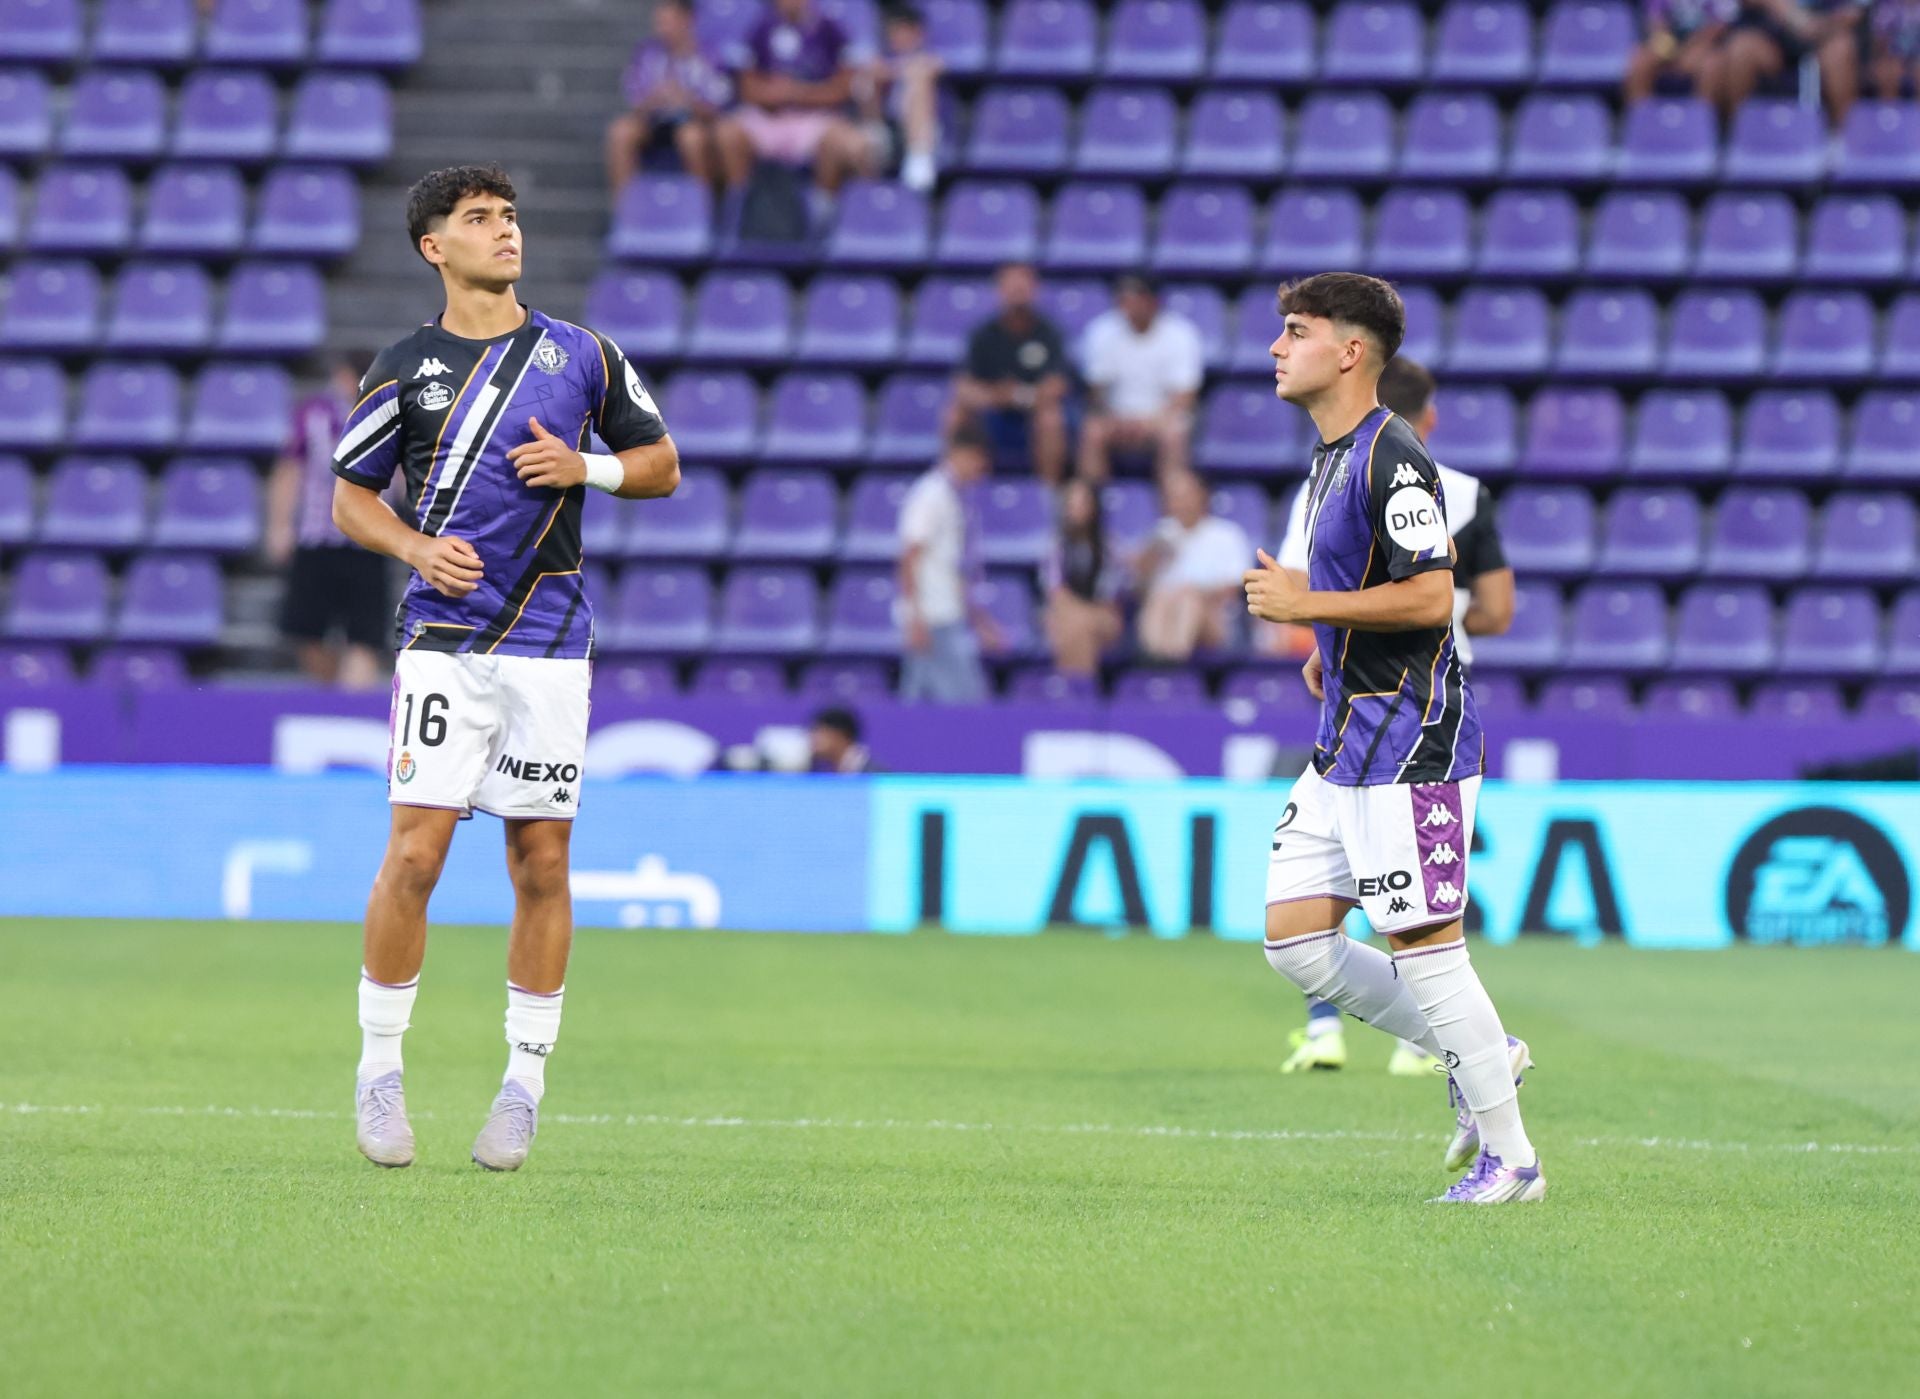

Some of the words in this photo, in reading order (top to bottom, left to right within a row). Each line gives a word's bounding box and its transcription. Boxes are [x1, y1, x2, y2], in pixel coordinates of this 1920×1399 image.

[1391, 508, 1438, 531] DIGI
[402, 693, 450, 747] 16
[496, 754, 578, 783] INEXO
[1353, 870, 1412, 897] EXO
